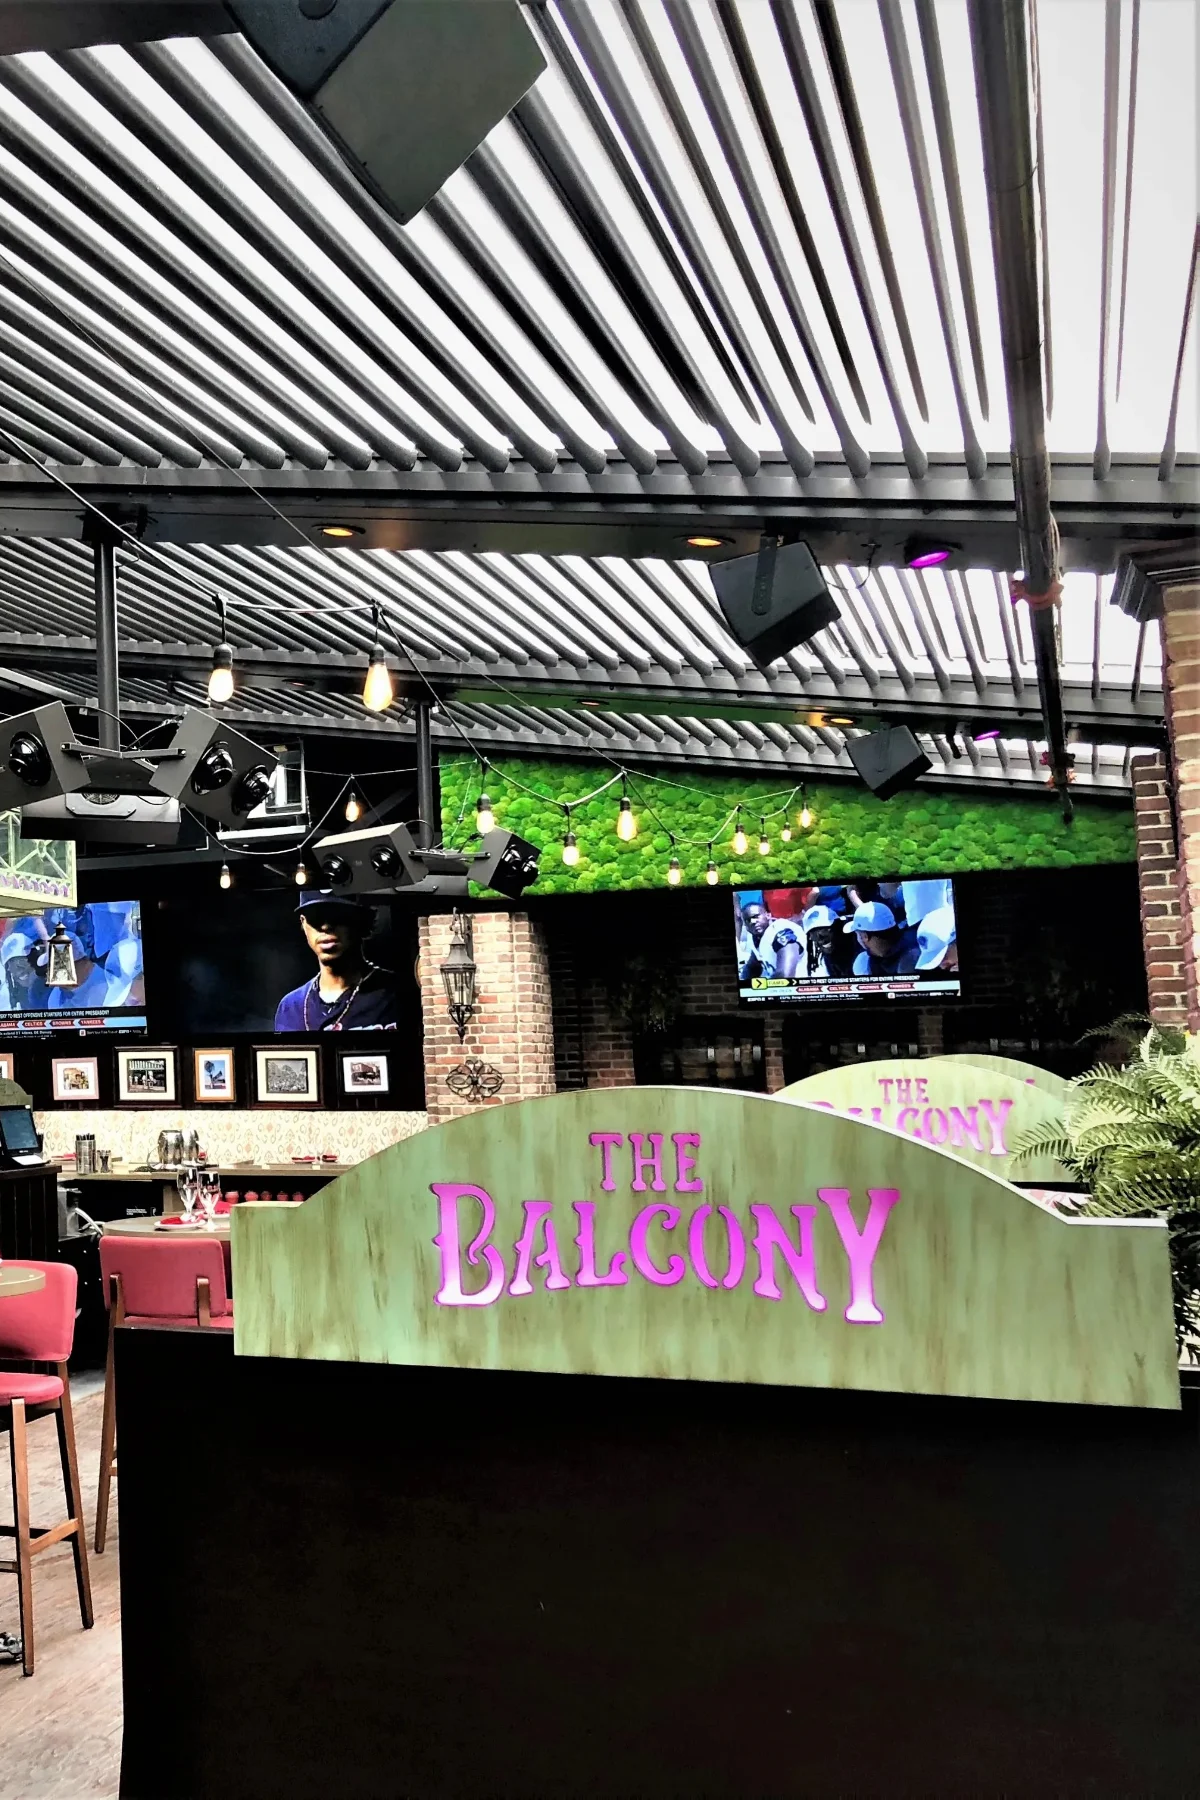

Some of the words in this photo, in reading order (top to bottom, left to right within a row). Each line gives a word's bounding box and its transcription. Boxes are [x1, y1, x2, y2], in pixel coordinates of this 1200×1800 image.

[878, 1078, 929, 1104] THE
[589, 1131, 704, 1193] THE
[429, 1182, 900, 1324] BALCONY
